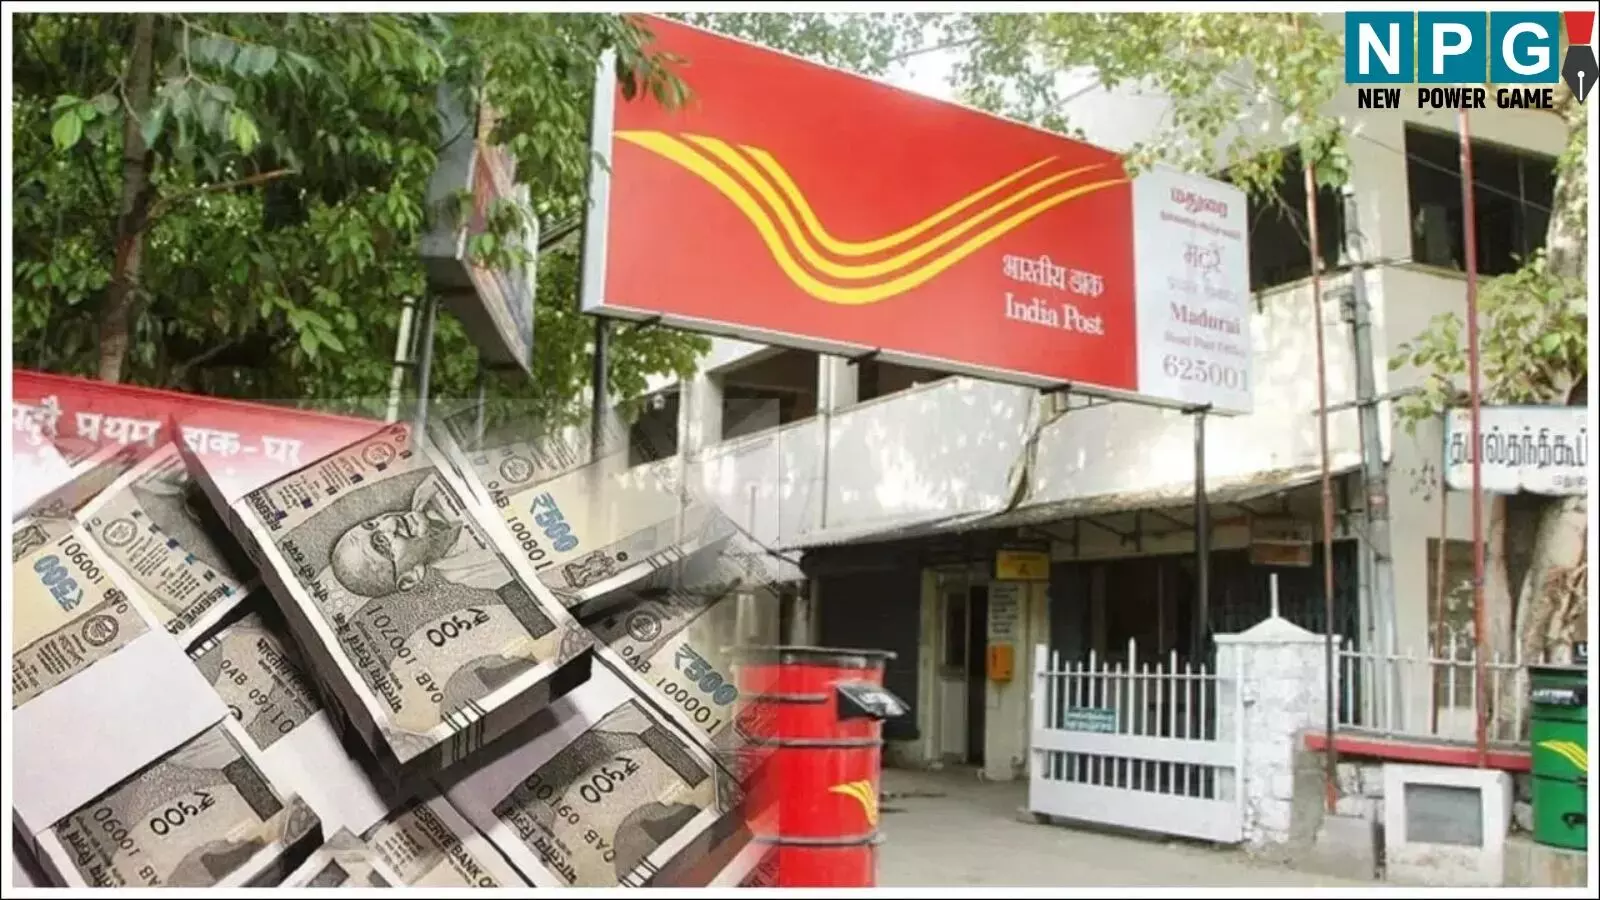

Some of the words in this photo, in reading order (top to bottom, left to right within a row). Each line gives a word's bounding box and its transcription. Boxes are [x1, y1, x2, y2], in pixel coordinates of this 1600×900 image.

[1002, 254, 1066, 291] भारतीय
[1068, 268, 1104, 298] डाक
[1004, 291, 1060, 328] India
[1061, 303, 1104, 336] Post
[1170, 301, 1241, 335] Madurai
[1162, 353, 1248, 393] 625001
[507, 516, 554, 570] 100801
[530, 492, 579, 552] ₹500
[57, 534, 104, 585] 100901
[367, 605, 417, 665] 100701
[674, 643, 738, 706] ₹500
[656, 677, 721, 734] 100001
[451, 844, 483, 879] BANK
